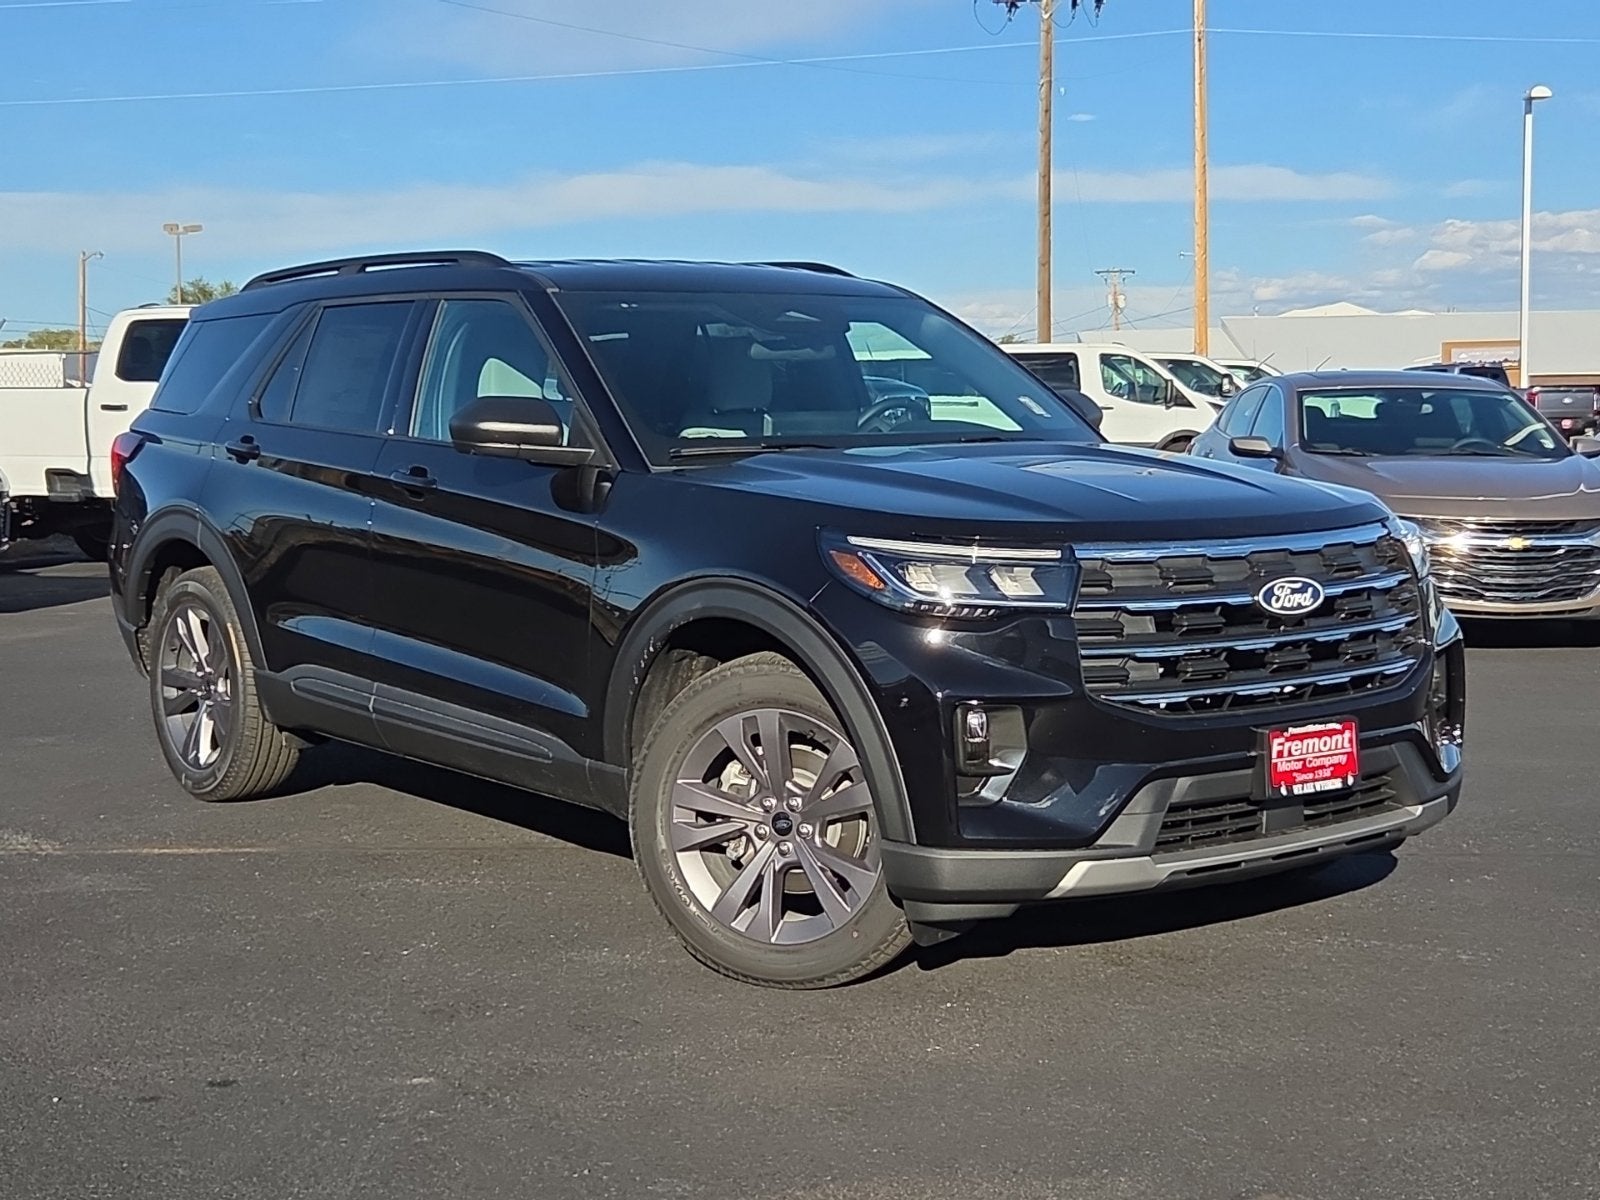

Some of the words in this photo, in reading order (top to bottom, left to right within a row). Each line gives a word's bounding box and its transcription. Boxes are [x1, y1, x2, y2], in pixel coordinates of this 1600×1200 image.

[1271, 582, 1314, 608] Ford
[1271, 729, 1351, 759] Fremont
[1276, 760, 1304, 773] Motor
[1306, 754, 1348, 767] Company
